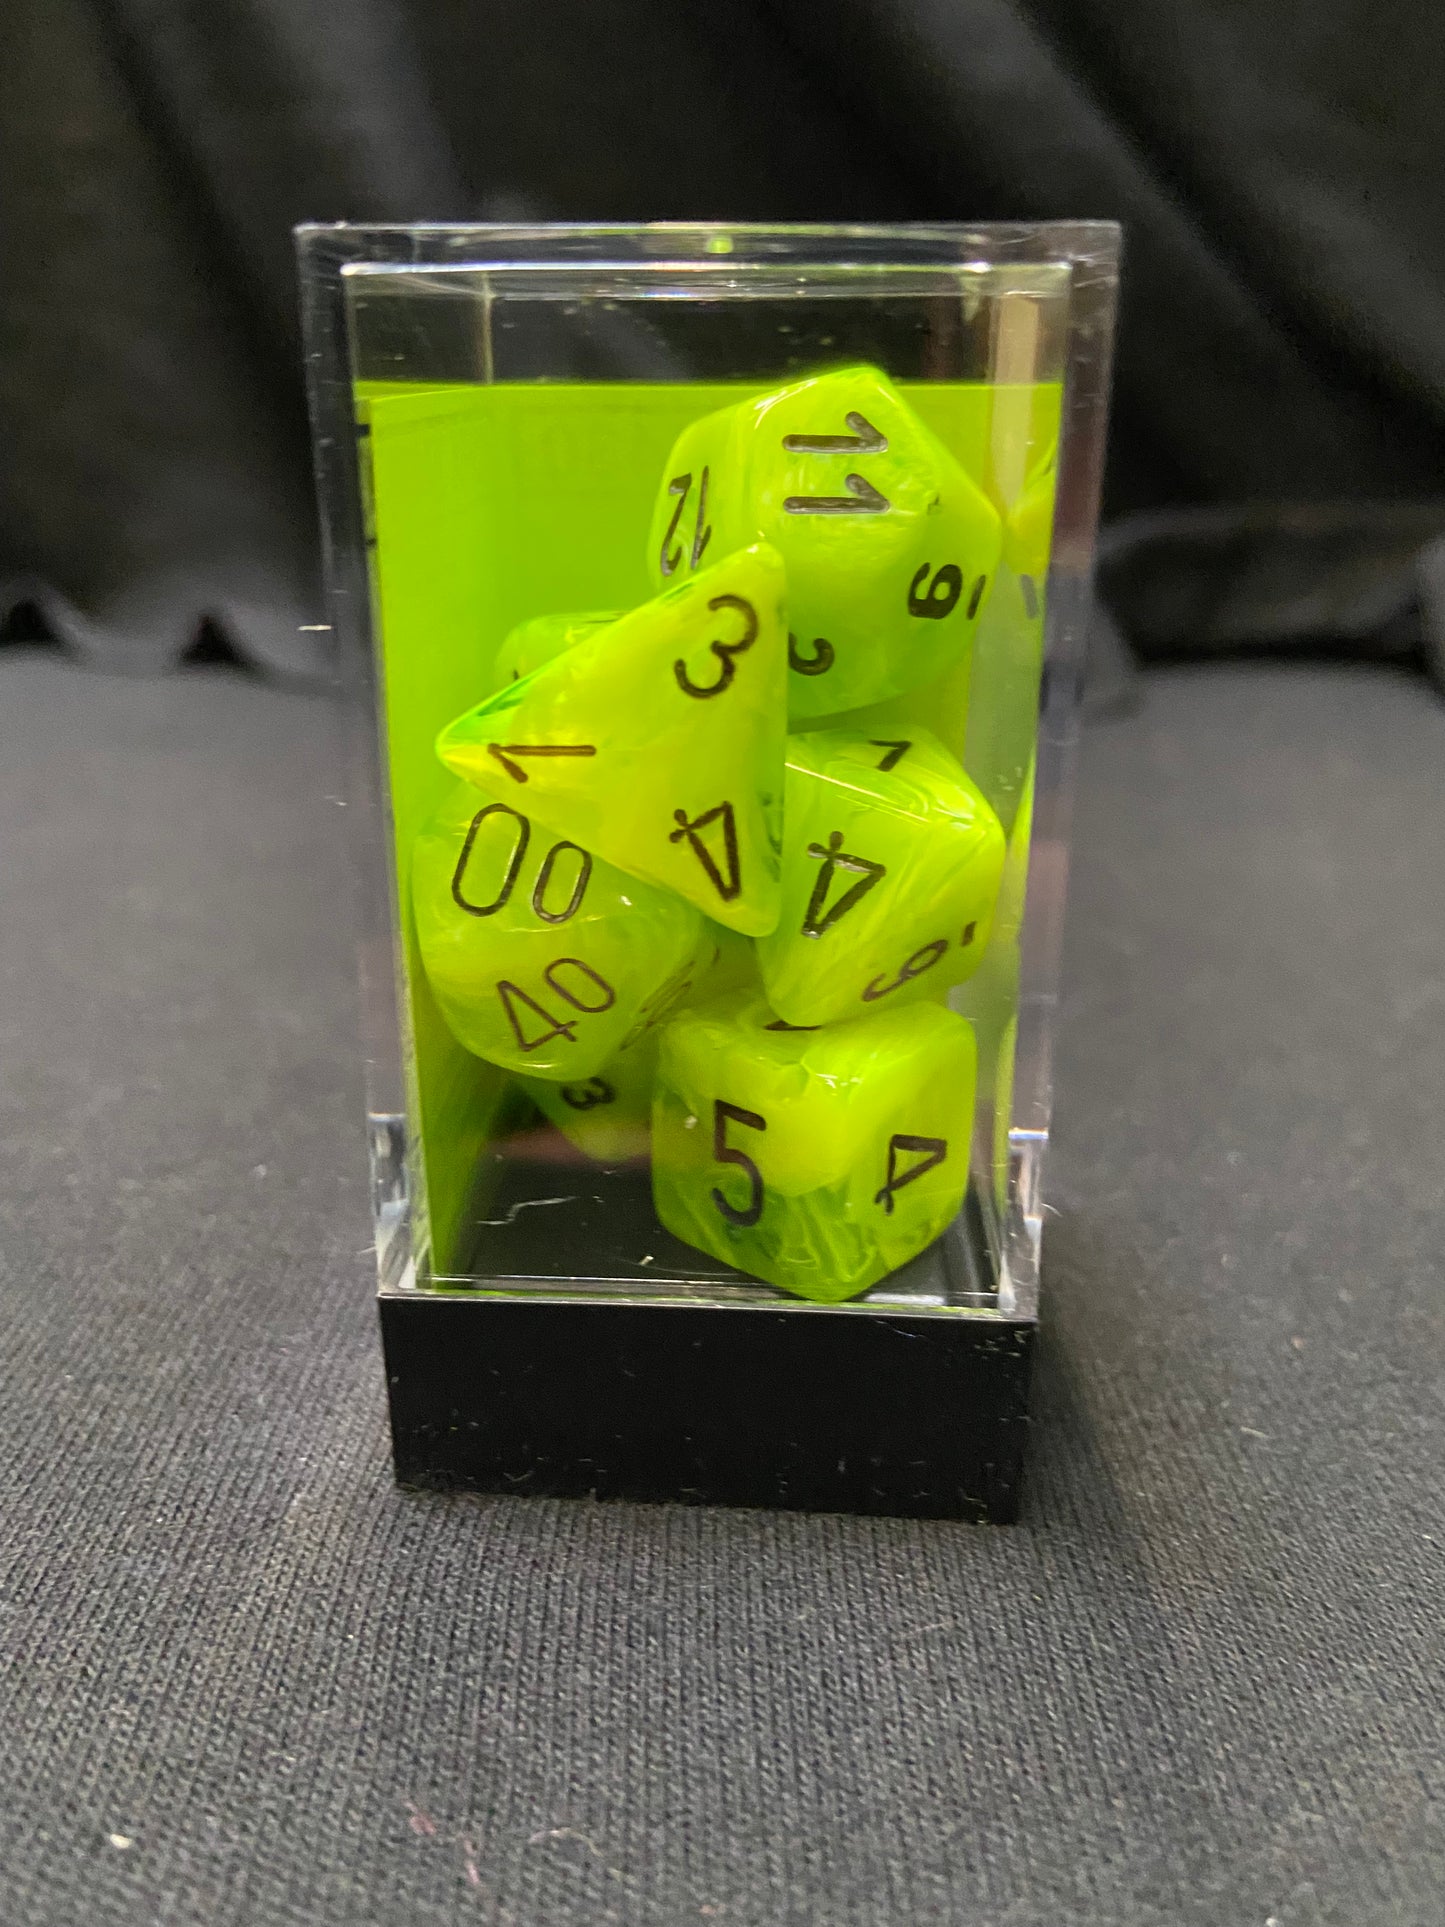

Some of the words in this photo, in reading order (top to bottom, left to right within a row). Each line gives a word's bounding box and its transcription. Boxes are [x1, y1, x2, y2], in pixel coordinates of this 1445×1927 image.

[782, 411, 891, 515] 11
[673, 593, 760, 700] 3
[487, 742, 597, 784] 1
[451, 802, 593, 924] 00
[669, 800, 742, 903] 4
[801, 830, 887, 940] 4
[495, 957, 616, 1052] 40
[711, 1099, 767, 1227] 5
[874, 1133, 948, 1216] 4
